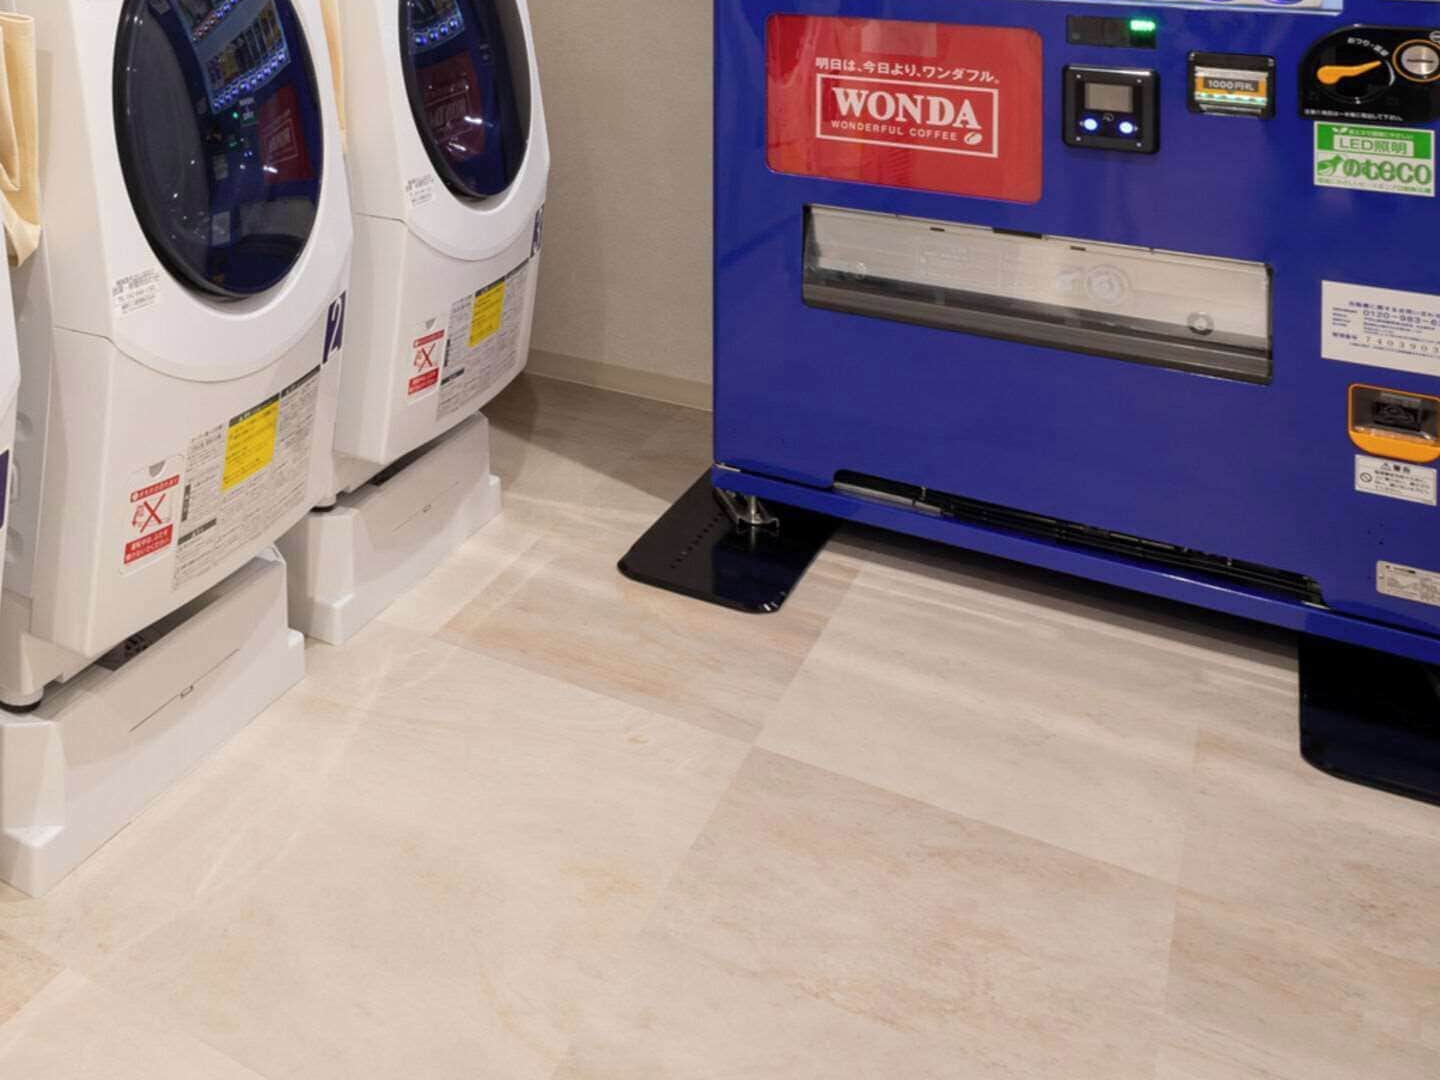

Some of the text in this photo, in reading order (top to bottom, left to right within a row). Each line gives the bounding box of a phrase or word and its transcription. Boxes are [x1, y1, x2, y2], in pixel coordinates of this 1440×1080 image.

[816, 56, 1000, 85] 明日は、今日より、ワンダフル。
[1208, 80, 1254, 92] 1000円札
[832, 86, 982, 130] WONDA
[831, 119, 958, 142] WONDERFUL COFFEE
[1339, 137, 1408, 155] LED照明
[1343, 158, 1432, 185] のむeco
